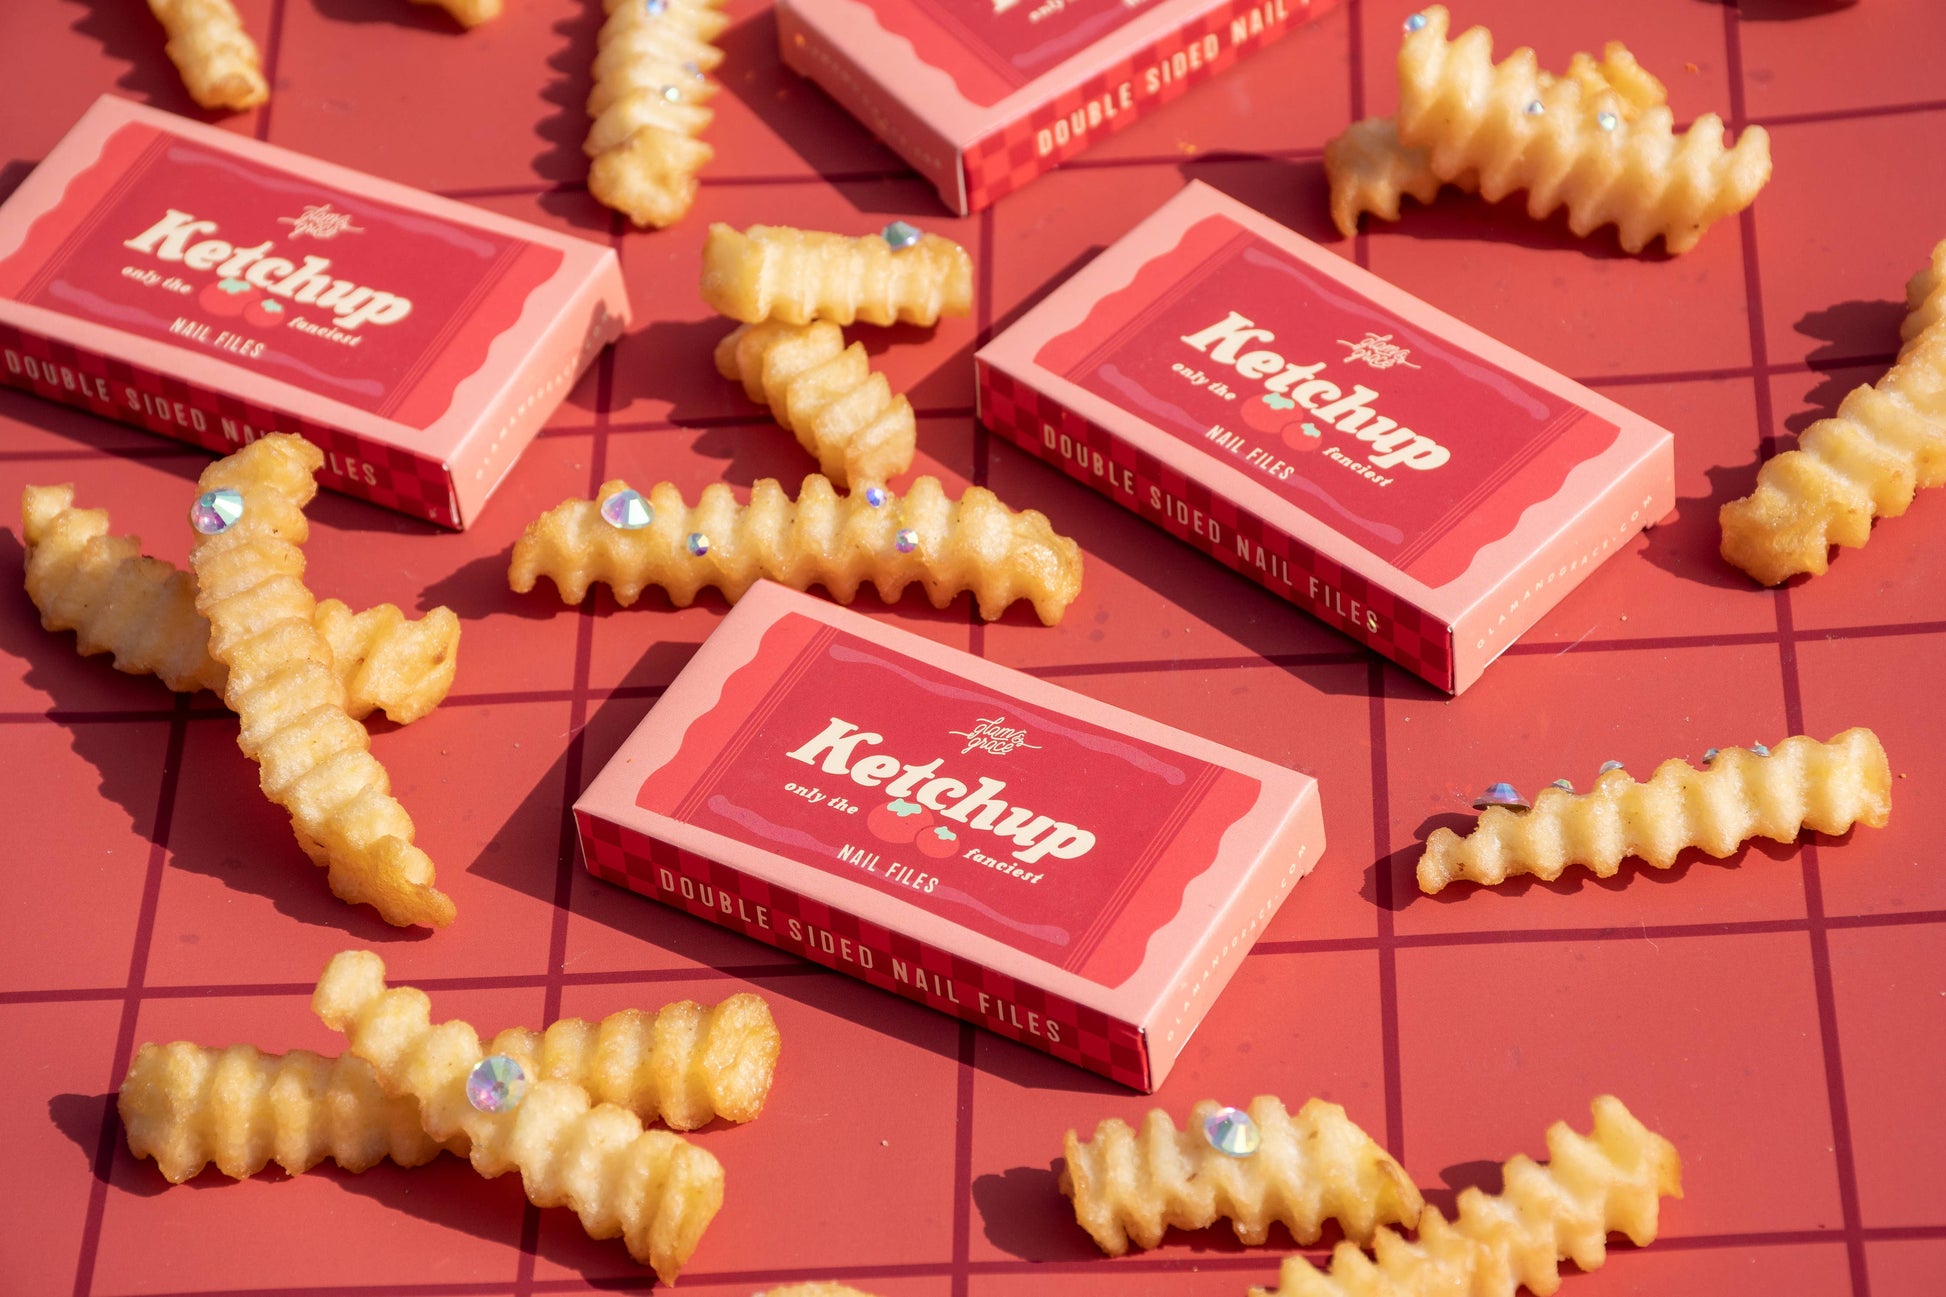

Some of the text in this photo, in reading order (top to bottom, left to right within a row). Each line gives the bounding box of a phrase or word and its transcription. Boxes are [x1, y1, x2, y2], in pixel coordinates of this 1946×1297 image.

[1037, 0, 1289, 157] DOUBLE SIDED NAIL
[121, 265, 193, 295] only the
[122, 208, 413, 330] Ketchup
[169, 316, 267, 358] NAIL FILES
[286, 316, 363, 347] fanciest
[1171, 362, 1237, 401] only the
[1180, 310, 1451, 471] Ketchup
[5, 349, 377, 487] DOUBLE SIDED NA LES
[1204, 424, 1296, 481] NAIL FILES
[1322, 446, 1395, 487] fanciest
[1043, 424, 1379, 635] DOUBLE SIDED NAIL FILES
[784, 781, 860, 816] only the
[785, 717, 1097, 864] Ketchup
[837, 843, 940, 894] NAIL FILES
[963, 848, 1045, 885] fanciest
[660, 868, 1061, 1044] DOUBLE SIDED NAIL FILES
